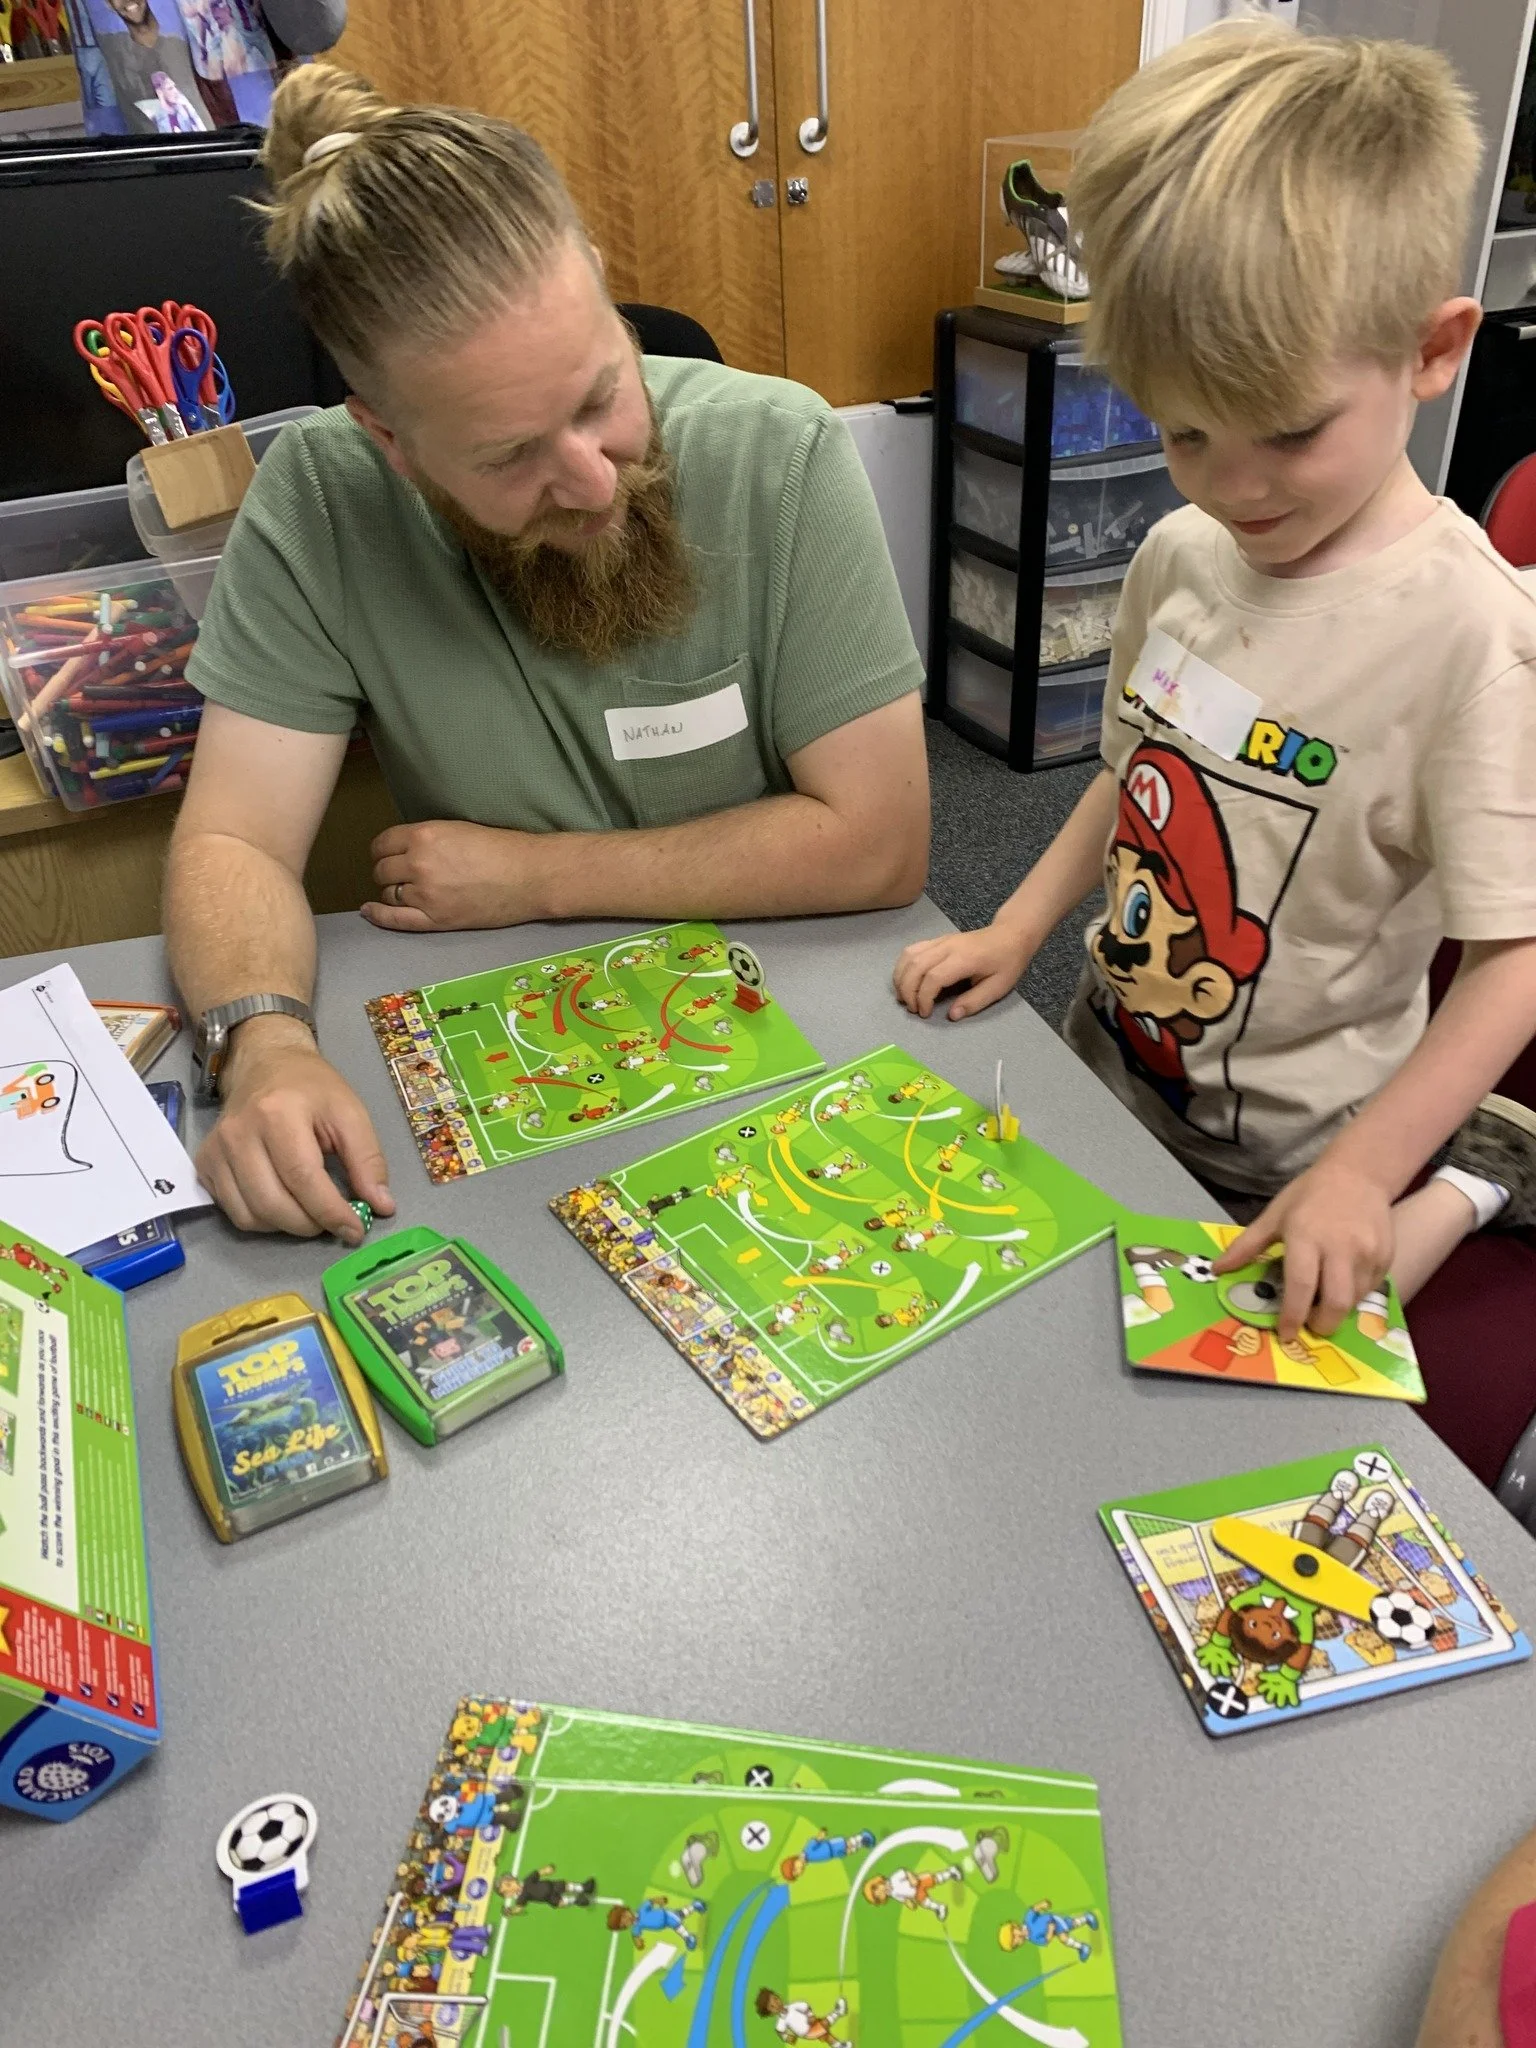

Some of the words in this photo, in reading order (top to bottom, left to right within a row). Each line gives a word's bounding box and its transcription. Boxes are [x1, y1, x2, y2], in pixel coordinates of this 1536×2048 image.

[623, 722, 684, 742] NATHAN
[1130, 772, 1161, 821] M
[367, 1259, 452, 1310] TOP
[379, 1274, 468, 1325] TRUMPS
[38, 1362, 45, 1371] as
[50, 1366, 57, 1374] of
[217, 1340, 299, 1383] TOP
[51, 1376, 60, 1398] game
[52, 1400, 60, 1429] exciting
[38, 1426, 47, 1471] backwards
[232, 1444, 282, 1476] Sea
[285, 1423, 341, 1456] Life
[52, 1457, 62, 1476] goal
[40, 1473, 49, 1494] pass
[54, 1478, 62, 1511] winning
[38, 1494, 47, 1512] ball
[54, 1514, 62, 1528] the
[40, 1531, 49, 1560] Watch
[56, 1559, 63, 1567] to
[68, 1743, 111, 1765] TOYS
